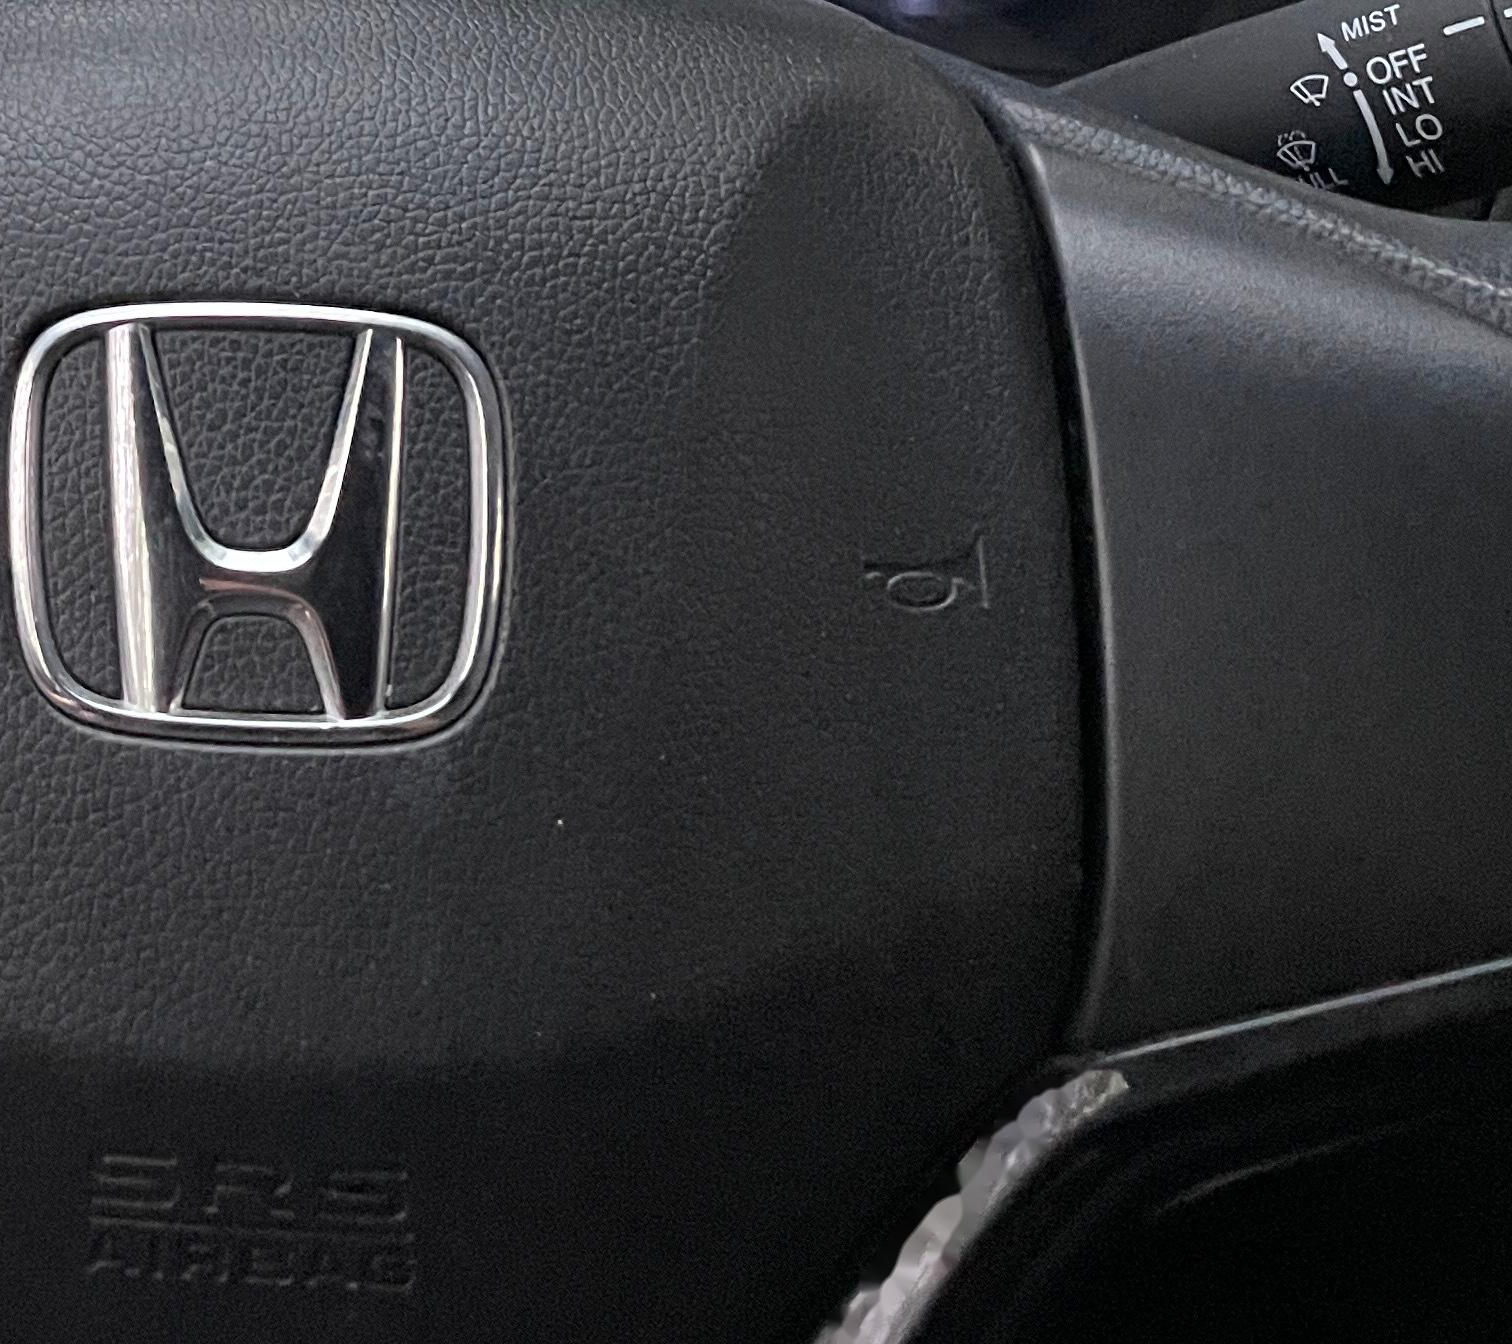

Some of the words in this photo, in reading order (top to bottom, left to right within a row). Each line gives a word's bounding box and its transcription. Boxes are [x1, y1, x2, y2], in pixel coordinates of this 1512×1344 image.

[1340, 3, 1402, 43] MIST
[1365, 42, 1429, 86] OFF
[1381, 75, 1436, 116] INT
[1395, 112, 1444, 149] LO
[1404, 148, 1445, 180] HI
